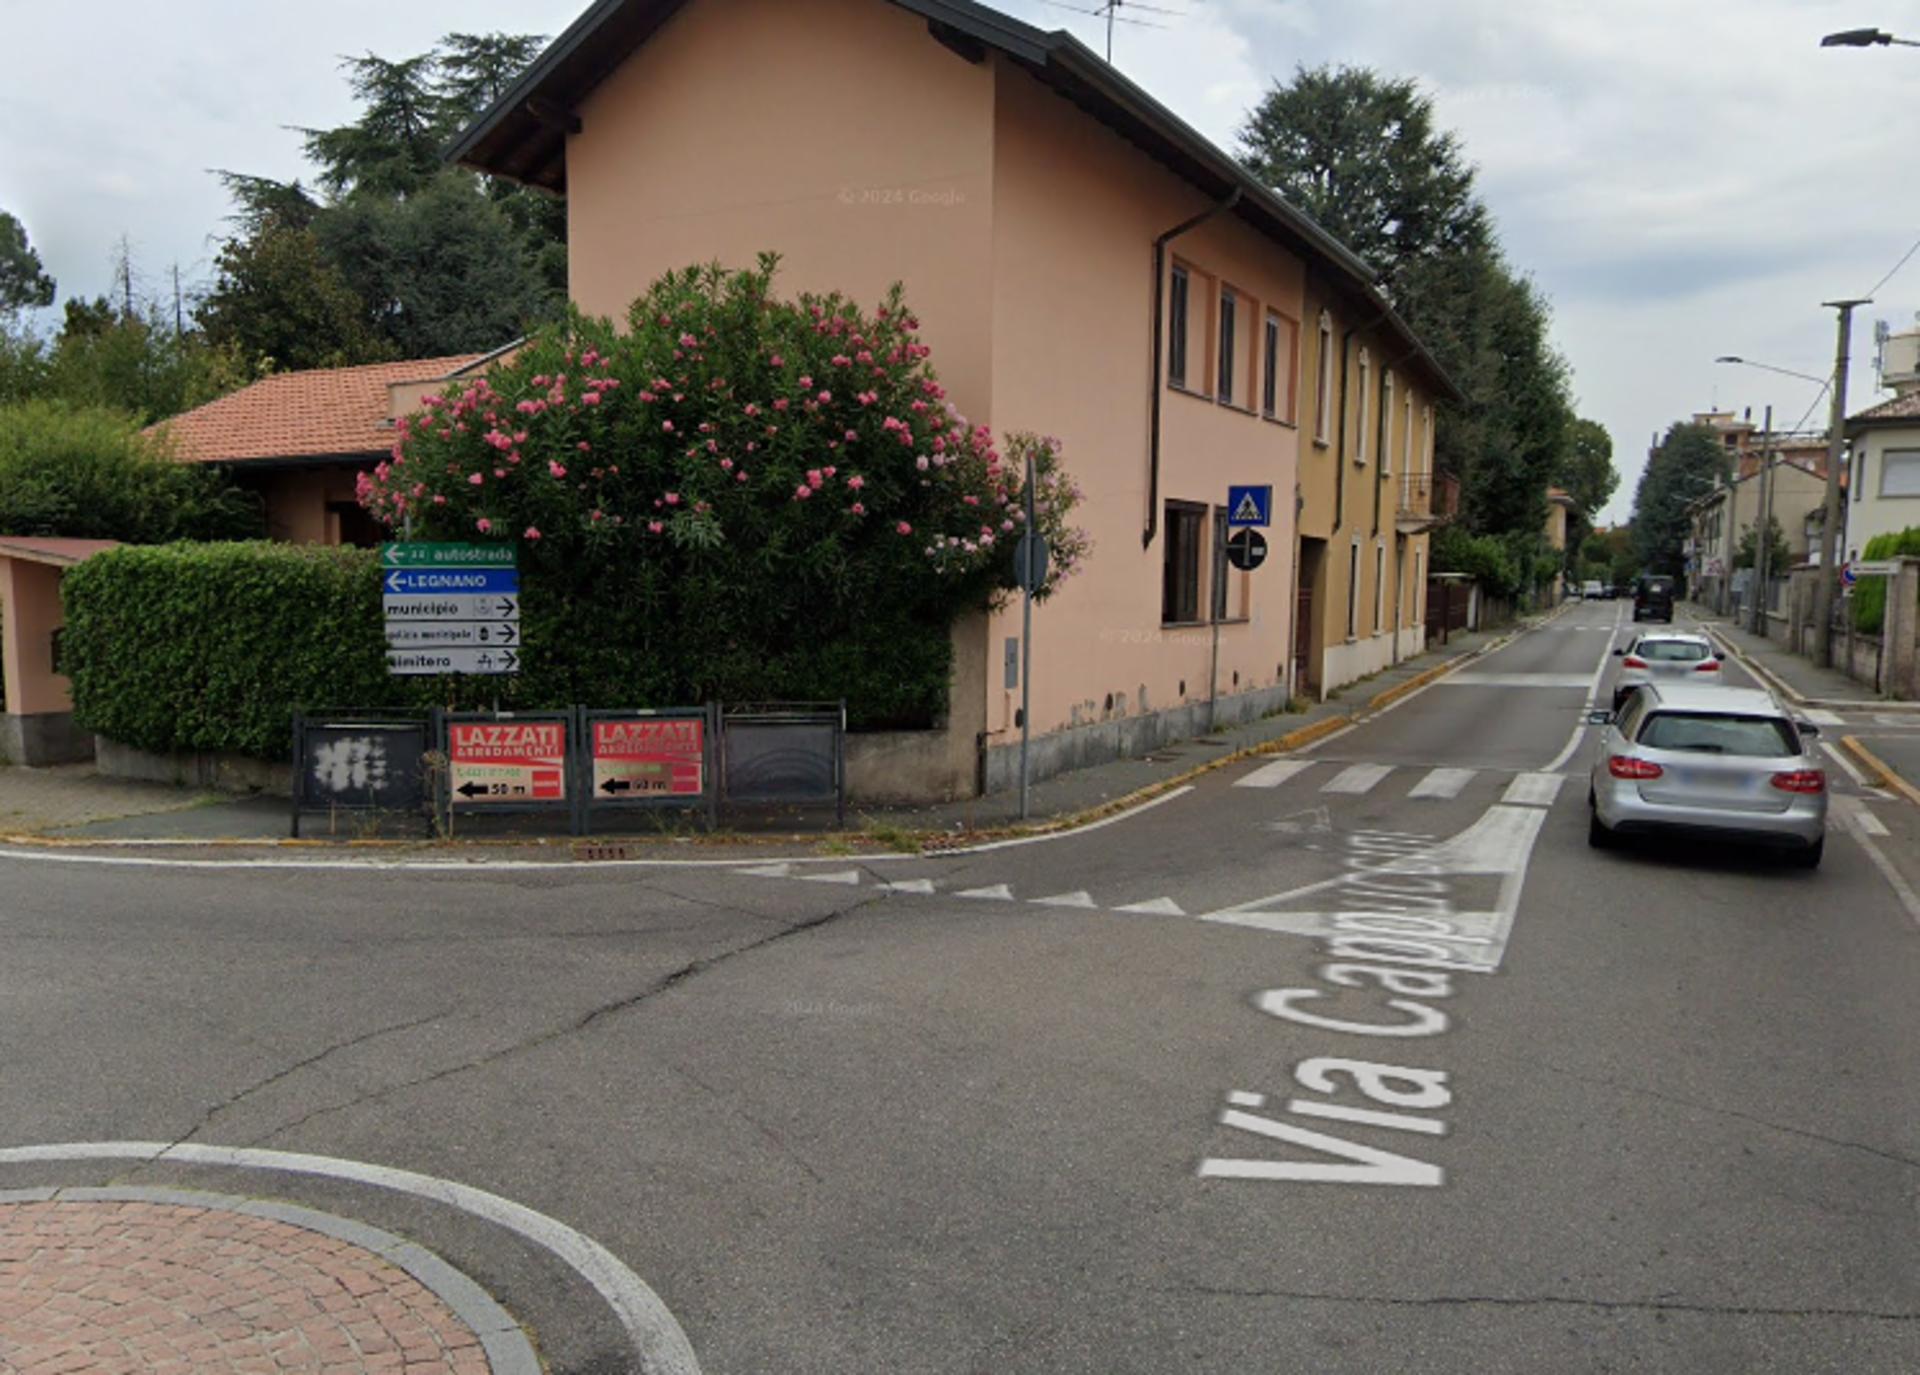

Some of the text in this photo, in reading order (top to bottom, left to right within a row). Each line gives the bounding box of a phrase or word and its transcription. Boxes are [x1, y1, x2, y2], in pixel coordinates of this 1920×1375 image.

[434, 546, 513, 561] autostrada
[407, 575, 487, 588] LEGNANO
[387, 603, 459, 615] municipio
[457, 726, 559, 747] LAZZATI
[599, 721, 697, 744] LAZZATI
